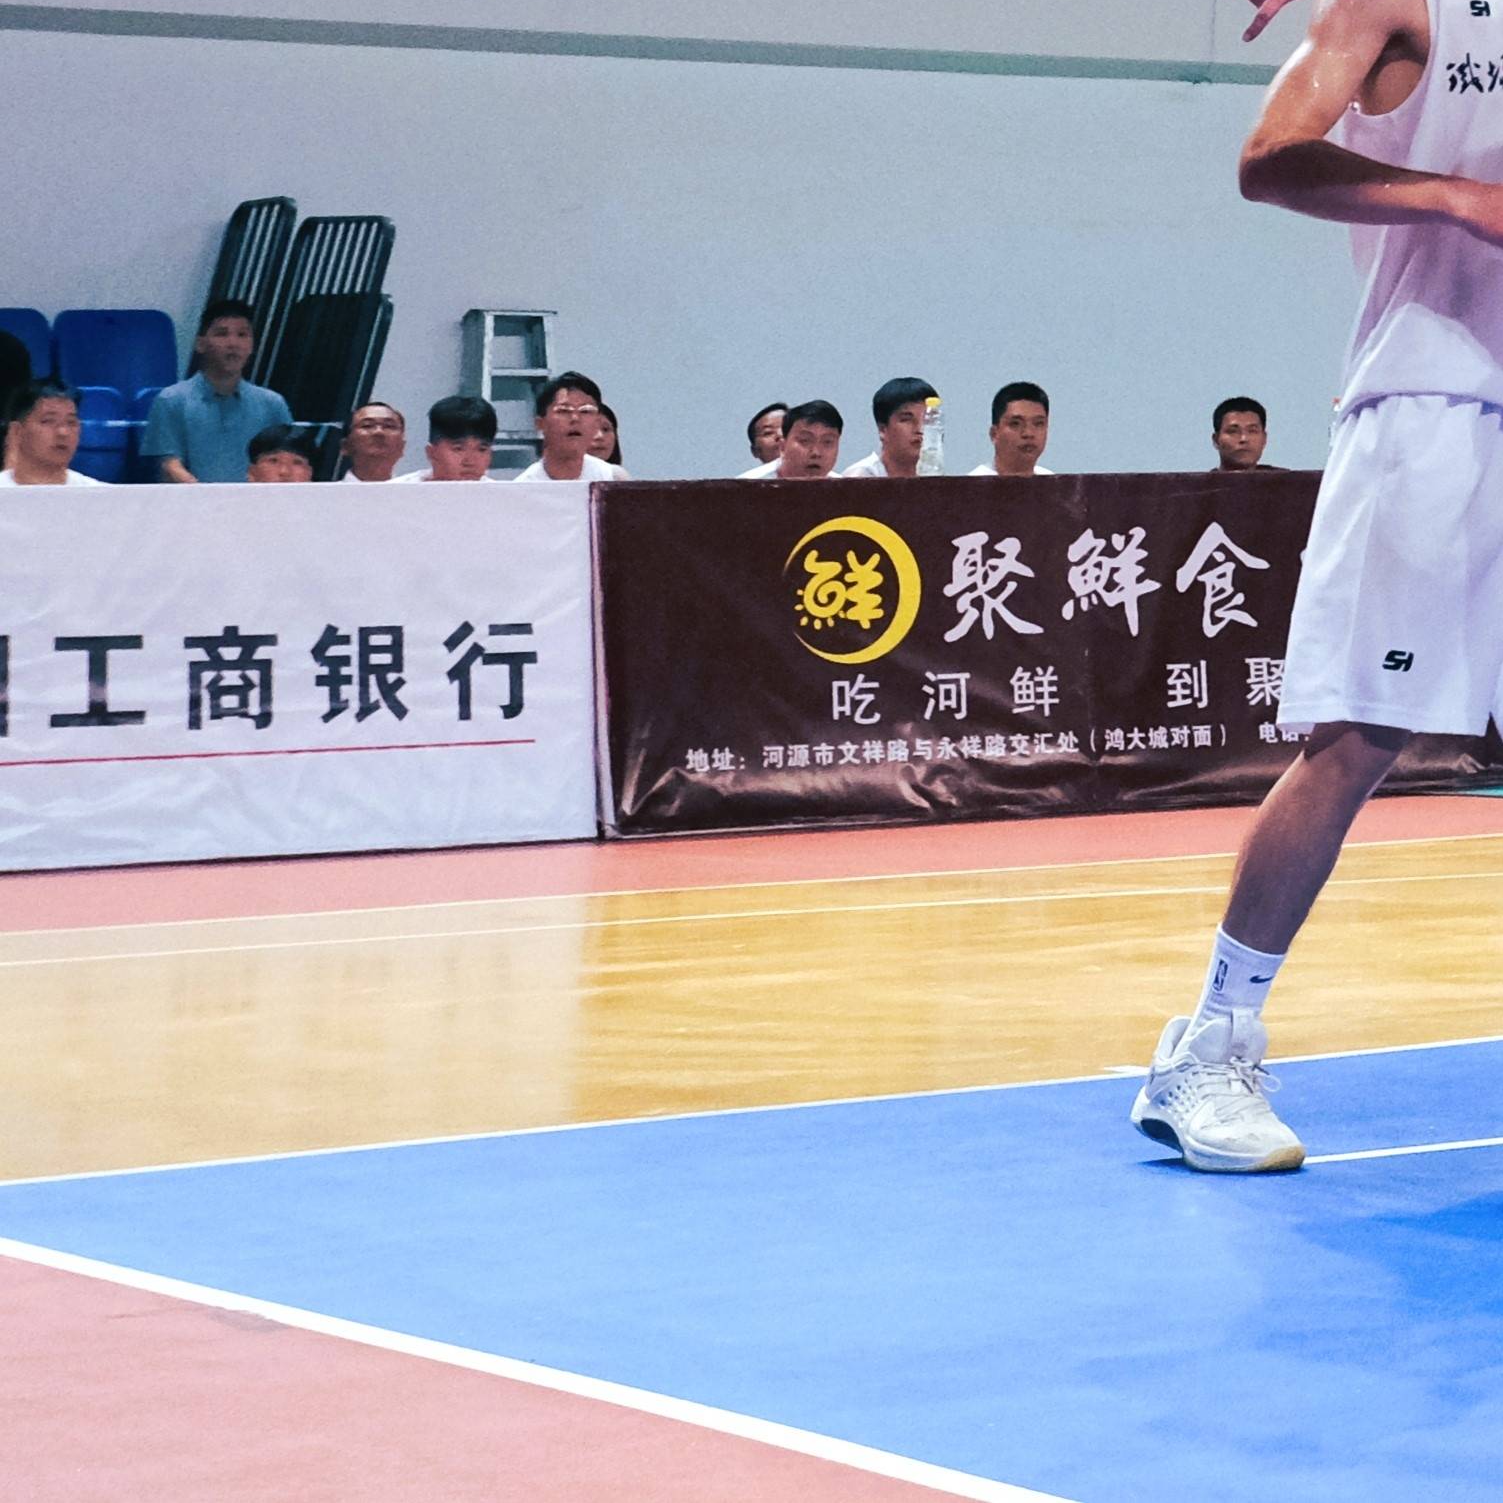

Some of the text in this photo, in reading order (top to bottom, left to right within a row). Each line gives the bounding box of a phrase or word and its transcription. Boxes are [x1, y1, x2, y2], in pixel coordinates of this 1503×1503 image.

[943, 520, 1271, 643] 聚鲜食
[0, 620, 538, 736] 工商银行
[831, 666, 1060, 726] 吃河鲜
